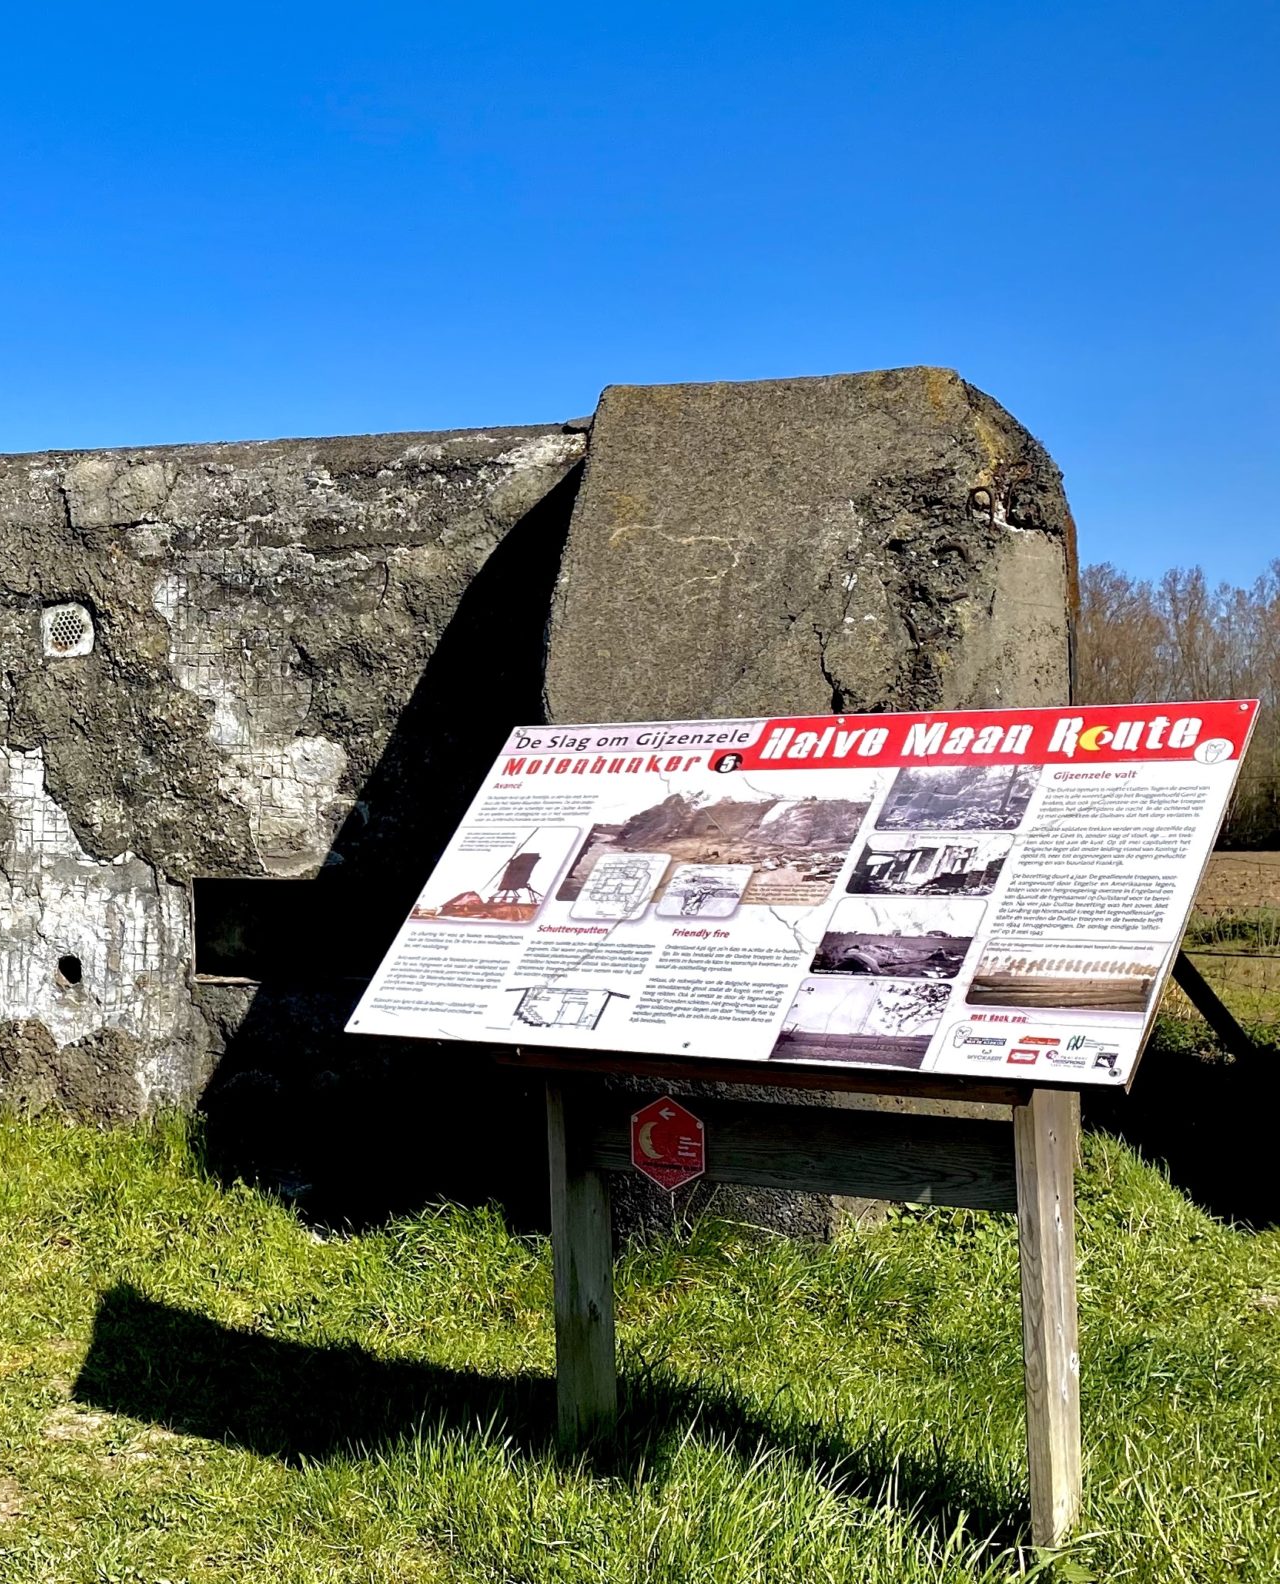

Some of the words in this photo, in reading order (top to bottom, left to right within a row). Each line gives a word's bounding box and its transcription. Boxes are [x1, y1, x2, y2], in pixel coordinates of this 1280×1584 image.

[517, 736, 545, 750] De
[547, 733, 591, 752] Slag
[597, 736, 631, 748] om
[636, 729, 750, 749] Gijzenzele
[759, 725, 890, 760] Halve
[901, 720, 1033, 757] Maan
[502, 752, 703, 777] Molenbunker
[719, 755, 736, 771] 5
[1053, 771, 1112, 782] Gijzenzele
[1115, 770, 1137, 779] valt
[537, 924, 609, 936] Schuttersputten
[672, 928, 712, 940] Friendly
[712, 929, 730, 938] fire
